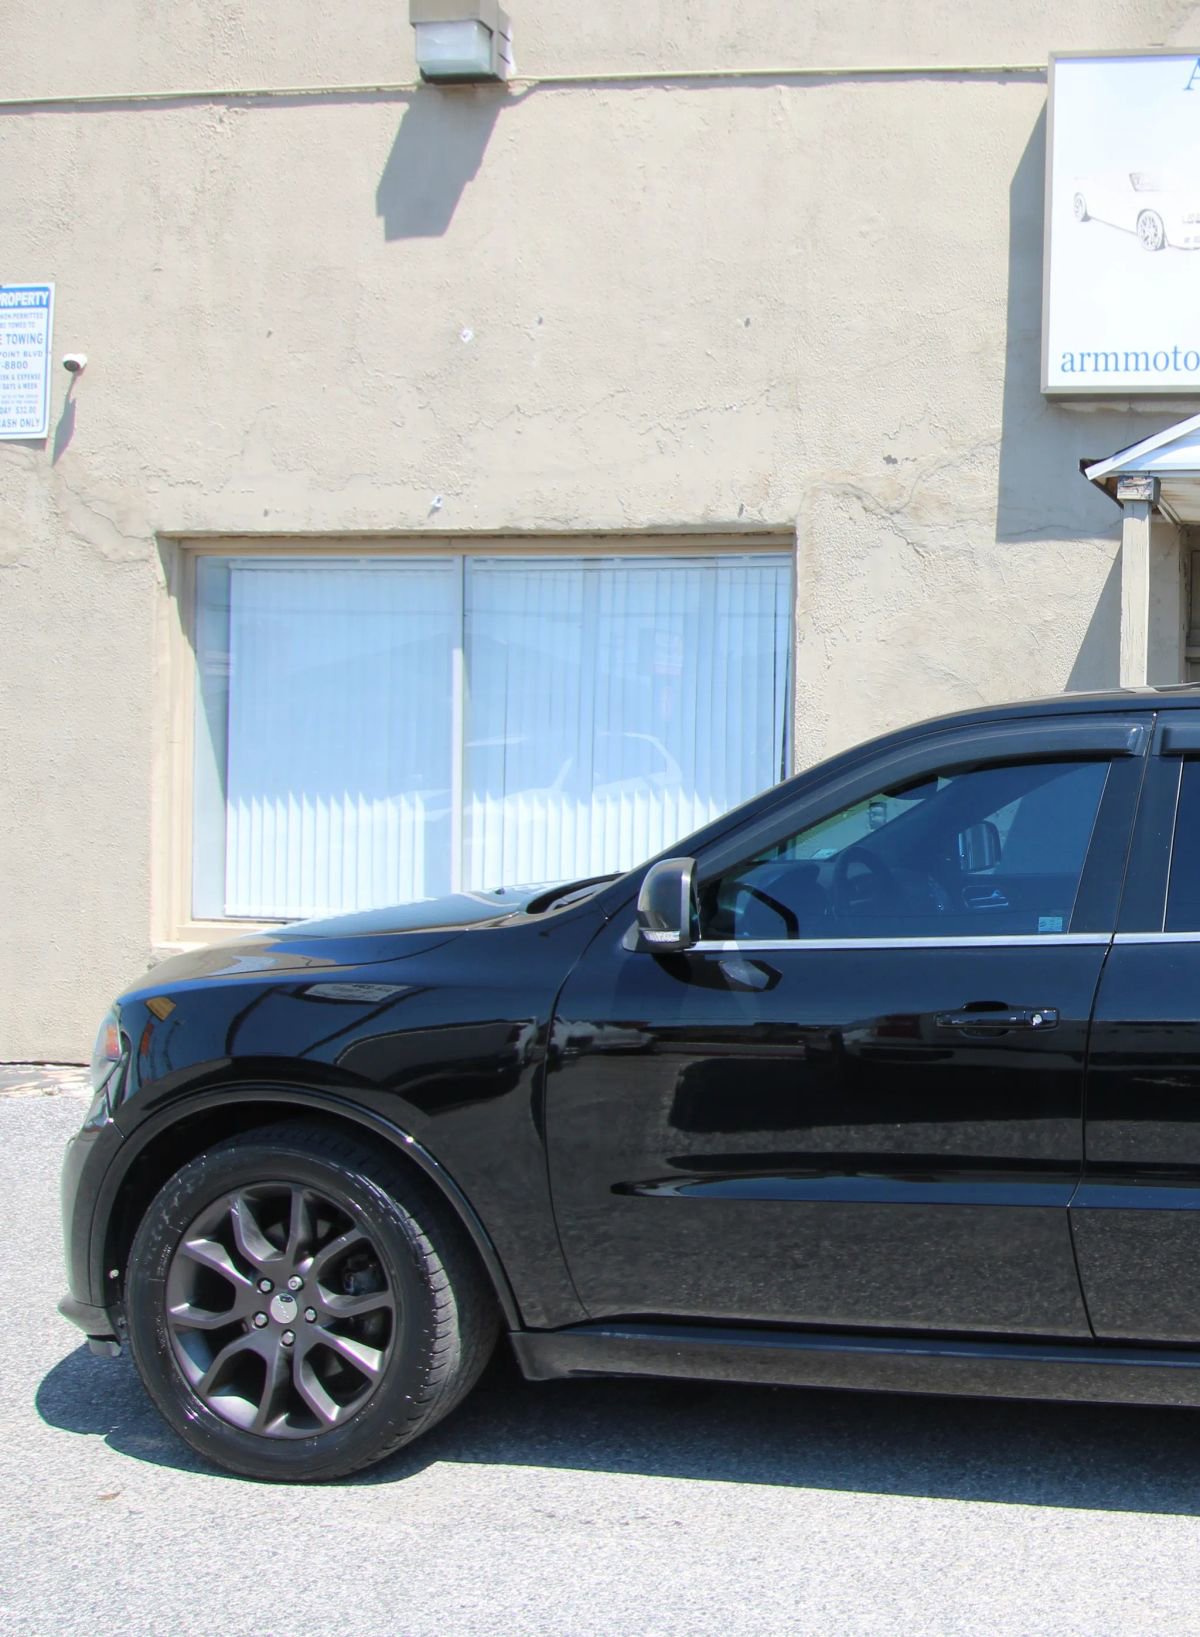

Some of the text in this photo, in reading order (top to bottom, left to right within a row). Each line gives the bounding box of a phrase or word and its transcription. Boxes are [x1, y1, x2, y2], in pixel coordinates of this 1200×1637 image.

[6, 333, 44, 345] TOWING
[23, 350, 43, 358] BLVD
[20, 417, 40, 428] ONLY
